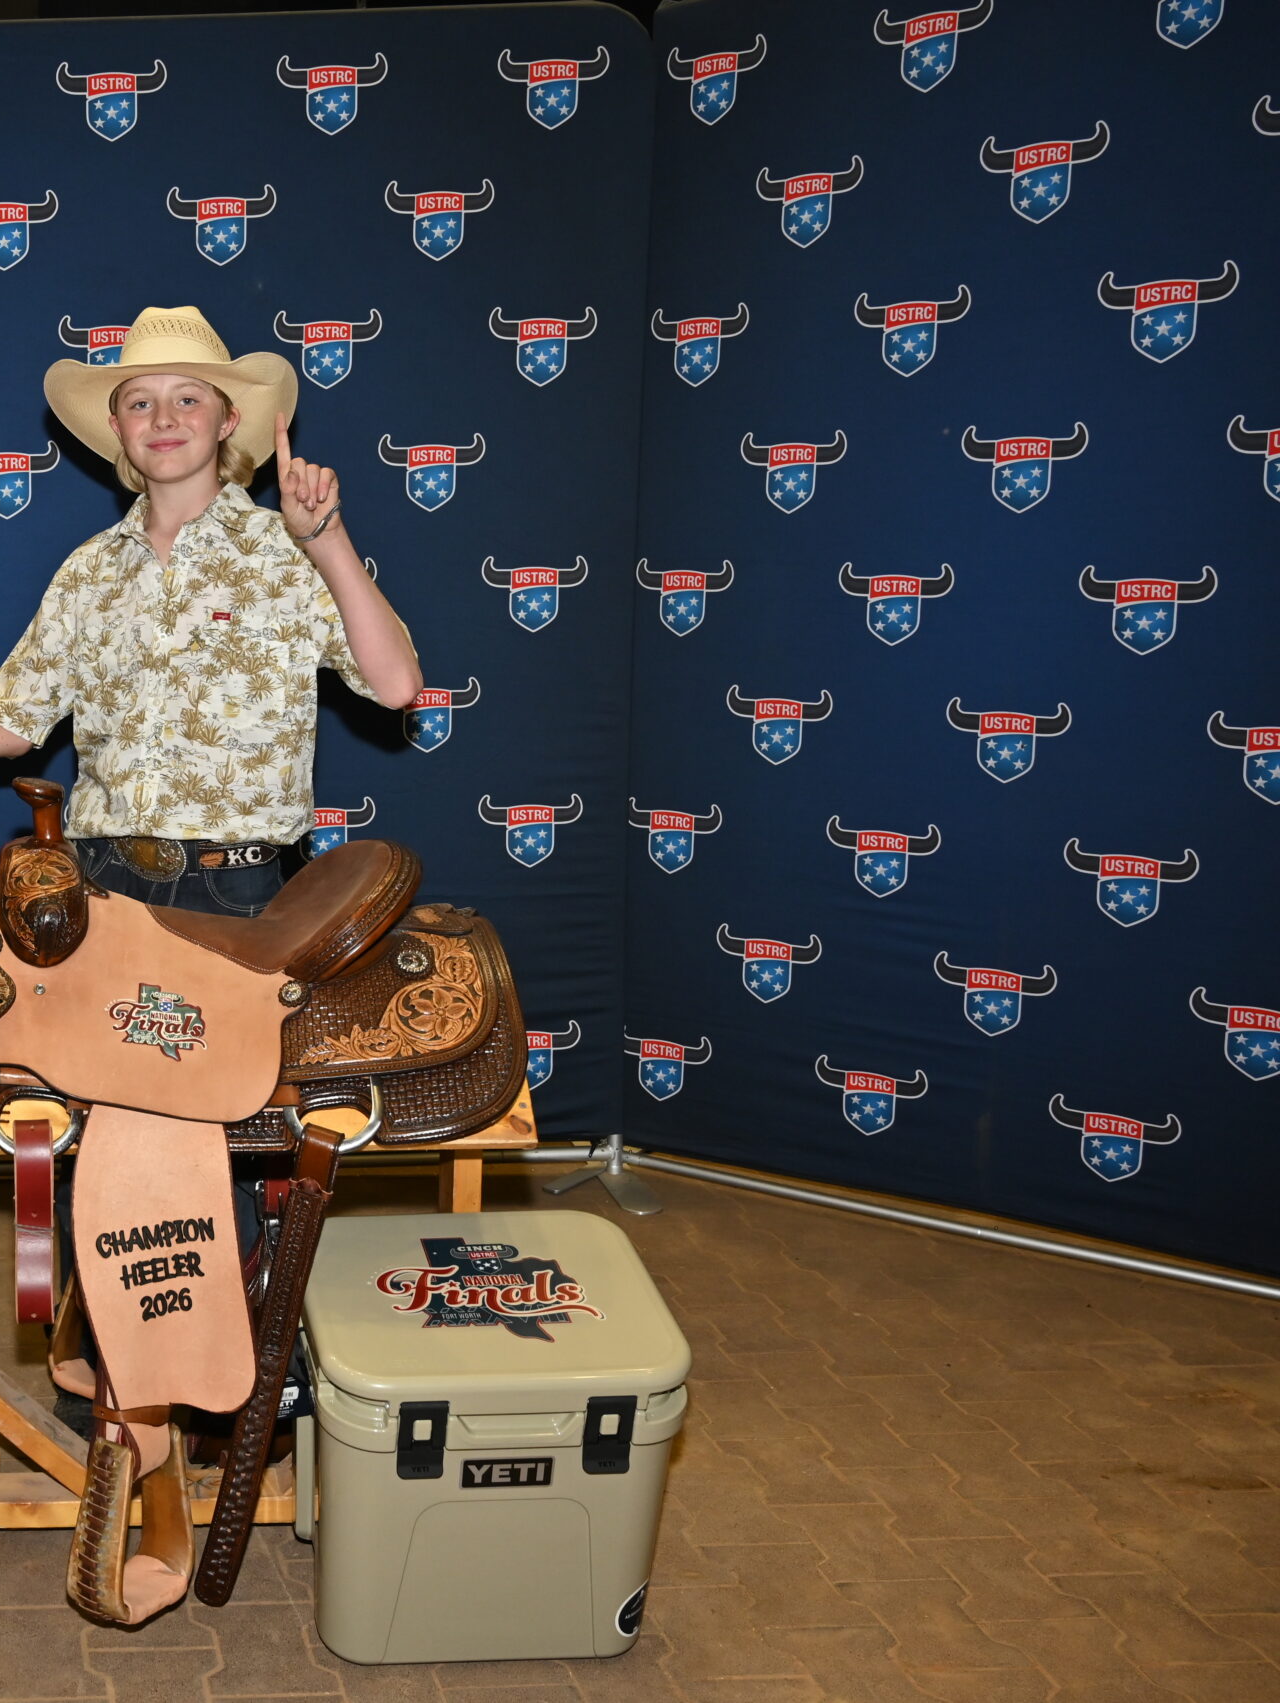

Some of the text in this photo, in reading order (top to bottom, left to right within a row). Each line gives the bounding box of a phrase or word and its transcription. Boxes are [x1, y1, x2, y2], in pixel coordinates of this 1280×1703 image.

[909, 15, 954, 36] USTRC
[533, 63, 574, 78] USTRC
[697, 56, 734, 74] USTRC
[91, 76, 132, 91] USTRC
[311, 70, 353, 84] USTRC
[1019, 145, 1067, 166] USTRC
[788, 177, 828, 195] USTRC
[201, 201, 242, 215] USTRC
[419, 196, 460, 210] USTRC
[1140, 284, 1192, 303] USTRC
[889, 305, 933, 322] USTRC
[307, 325, 348, 339] USTRC
[522, 323, 563, 336] USTRC
[680, 321, 717, 336] USTRC
[92, 330, 129, 344] USTR
[411, 449, 452, 462] USTRC
[772, 447, 813, 462] USTRC
[1000, 441, 1047, 457] USTRC
[515, 571, 555, 584] USTRC
[665, 574, 702, 588] USTRC
[873, 579, 917, 593] USTRC
[1121, 584, 1172, 598] USTRC
[417, 692, 448, 705] STRC
[758, 702, 798, 717] USTRC
[984, 716, 1031, 731] USTRC
[1252, 731, 1280, 746] UST
[314, 812, 344, 825] STRC
[511, 808, 550, 821] USTRC
[654, 813, 691, 829] USTRC
[861, 834, 904, 850] USTRC
[227, 847, 262, 866] KC
[1105, 858, 1155, 876] USTRC
[748, 942, 788, 958] USTRC
[971, 971, 1017, 989] USTRC
[109, 1001, 207, 1048] Finals
[151, 1012, 181, 1022] NATIONAL
[1233, 1010, 1280, 1030] USTR
[527, 1035, 549, 1047] TRC
[644, 1042, 680, 1058] USTRC
[849, 1074, 891, 1092] USTRC
[1089, 1116, 1138, 1136] USTRC
[96, 1217, 215, 1259] CHAMPION
[120, 1251, 205, 1290] HEELER
[463, 1274, 525, 1286] NATIONAL
[376, 1266, 600, 1317] Finals
[140, 1287, 193, 1322] 2026
[466, 1462, 546, 1484] YETI
